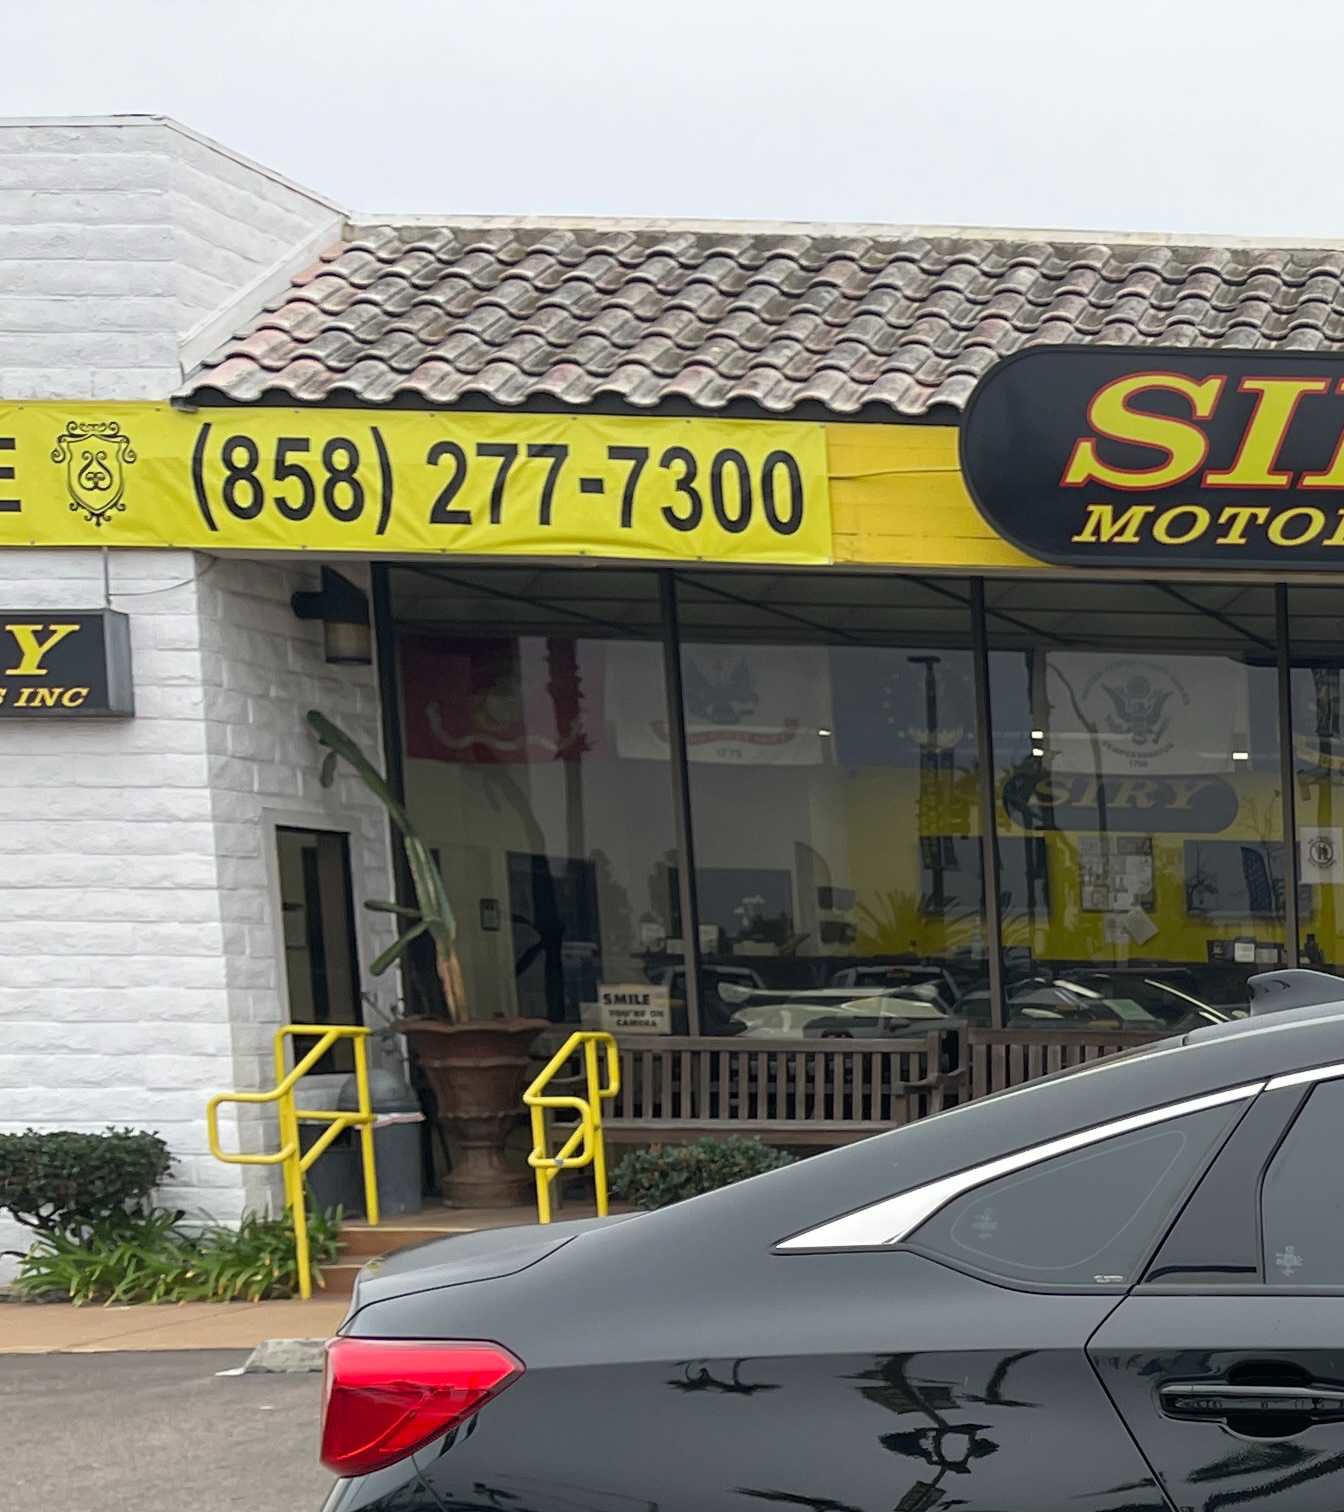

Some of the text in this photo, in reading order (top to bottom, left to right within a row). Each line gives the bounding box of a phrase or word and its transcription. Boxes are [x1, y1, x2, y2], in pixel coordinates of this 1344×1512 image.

[191, 421, 804, 536] (858) 277-7300
[14, 687, 90, 707] INC
[603, 992, 649, 1006] SMILE
